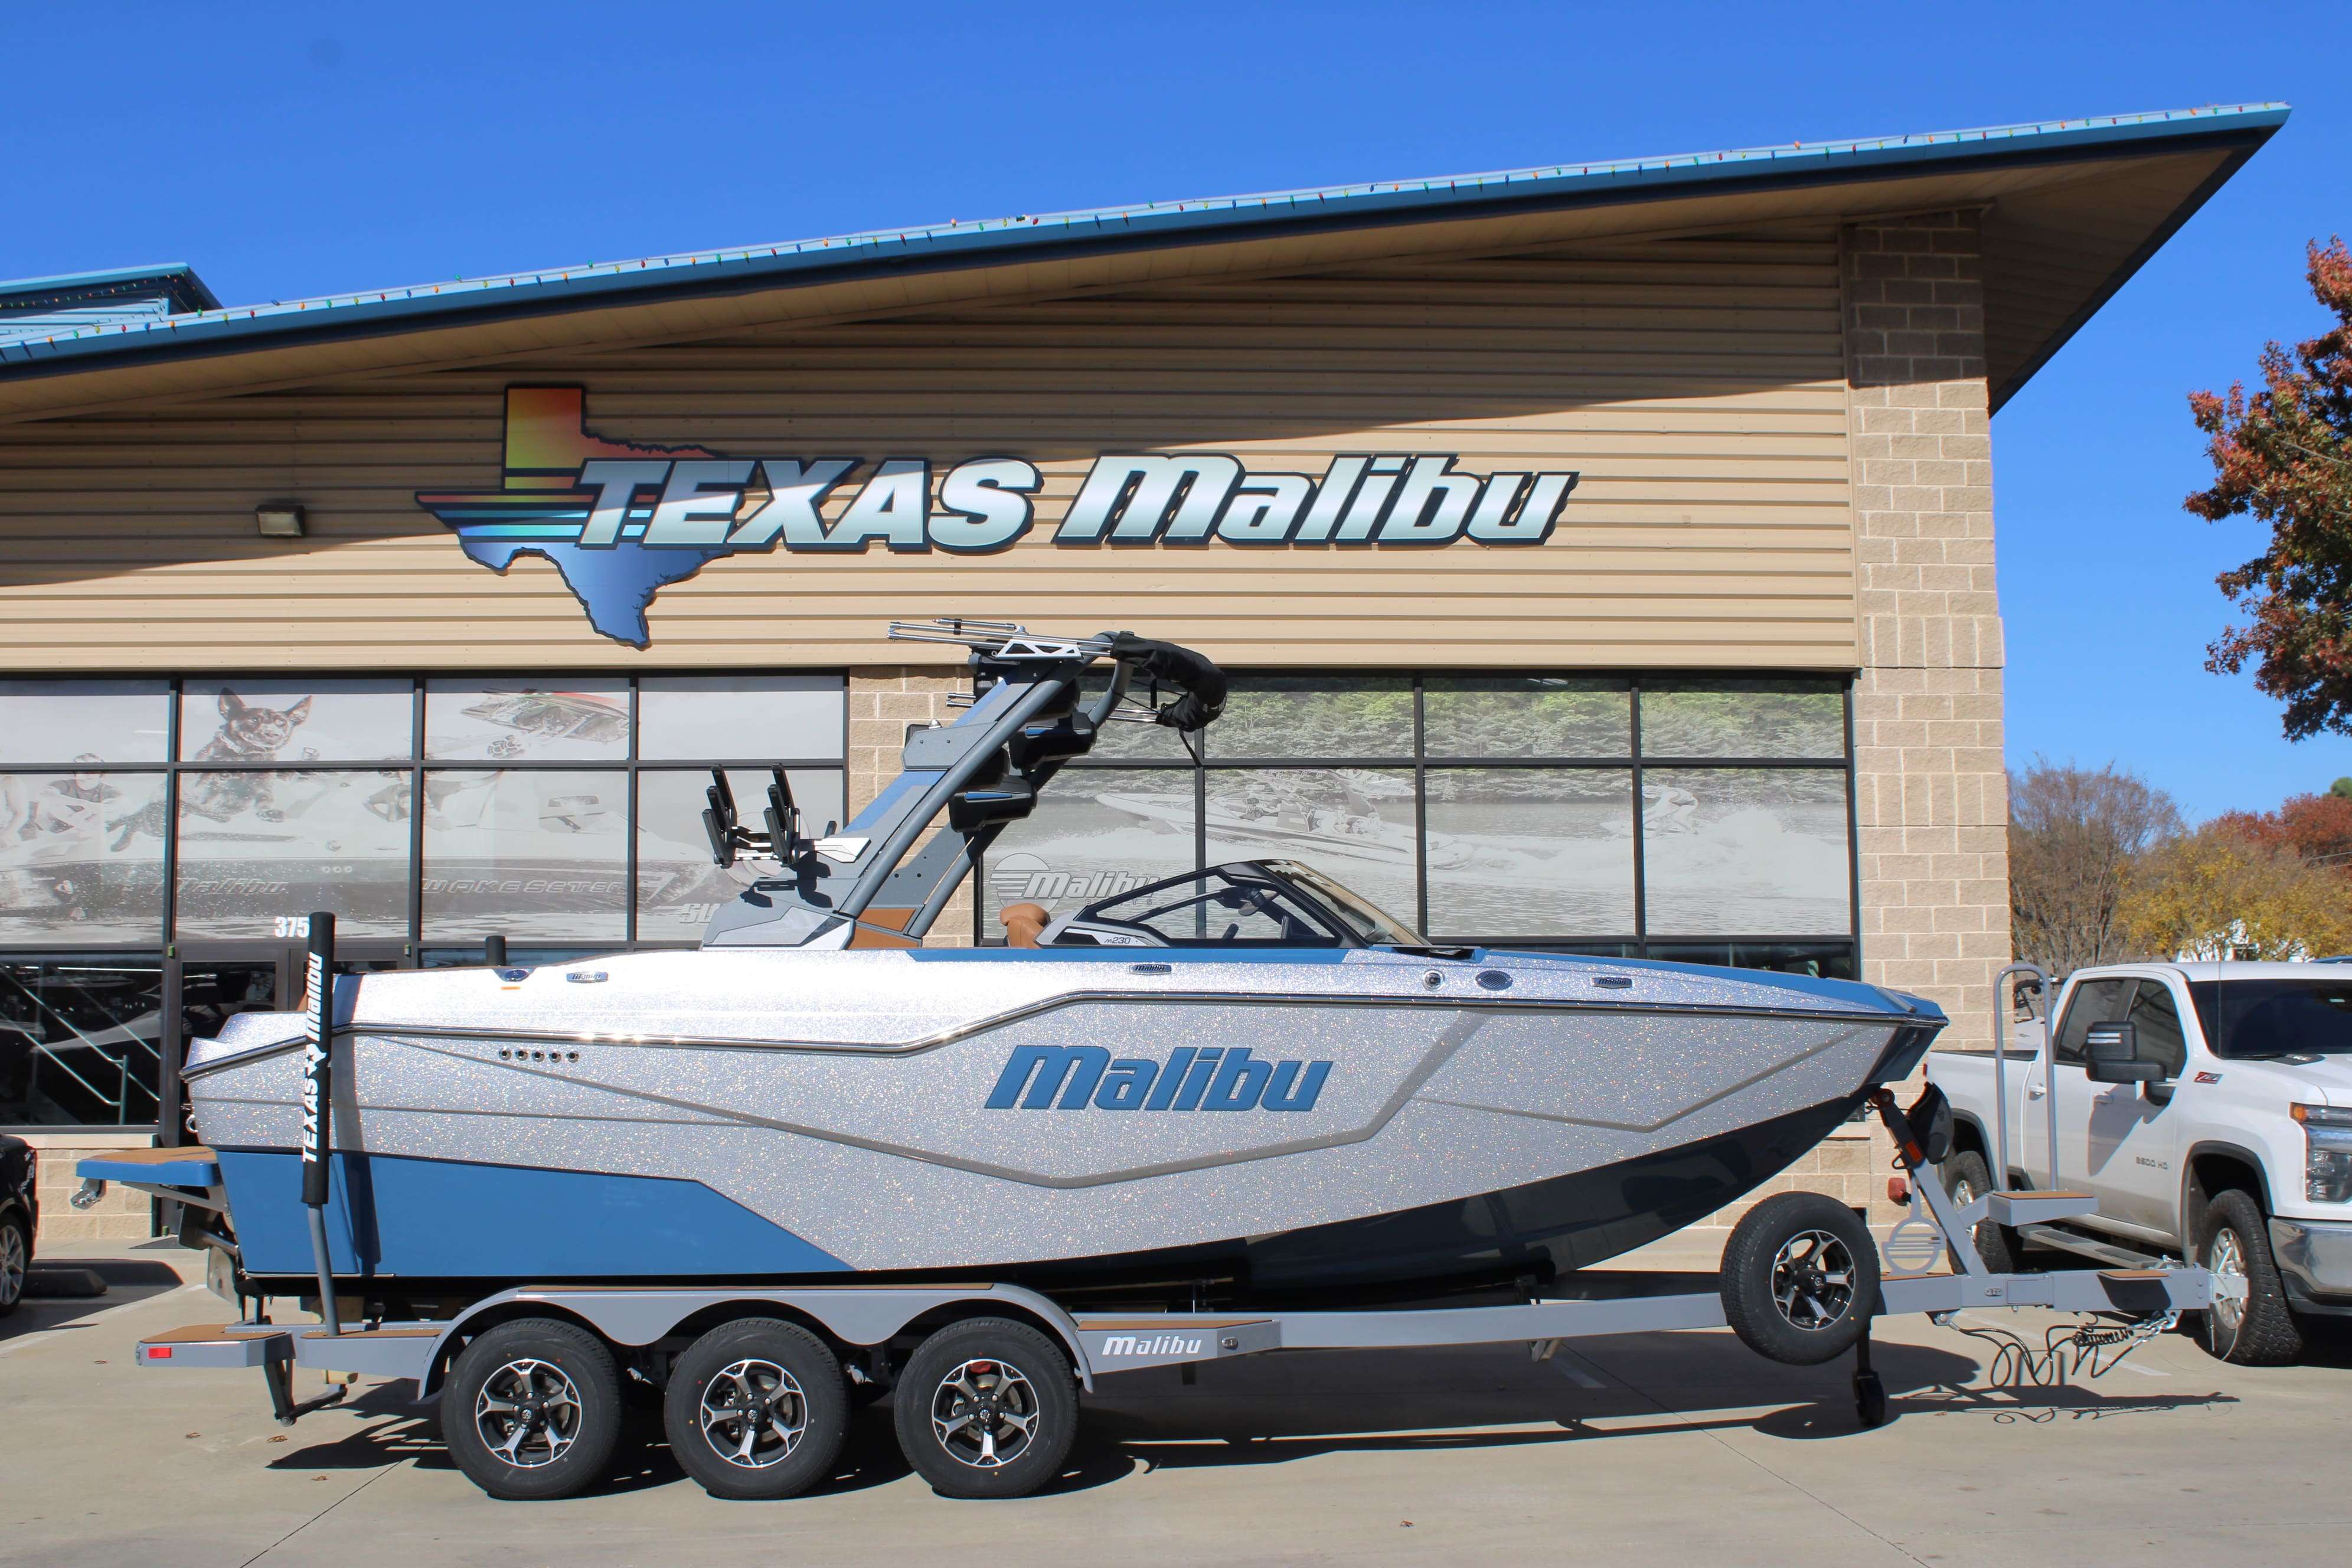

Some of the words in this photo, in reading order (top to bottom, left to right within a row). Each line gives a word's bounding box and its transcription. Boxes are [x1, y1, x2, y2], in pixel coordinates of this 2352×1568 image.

[575, 456, 1043, 553] TEXAS
[1053, 452, 1580, 545] Malibu
[275, 916, 310, 937] 375
[984, 1045, 1334, 1111] Malibu
[302, 1078, 319, 1162] TEXAS
[1102, 1335, 1202, 1355] Malibu
